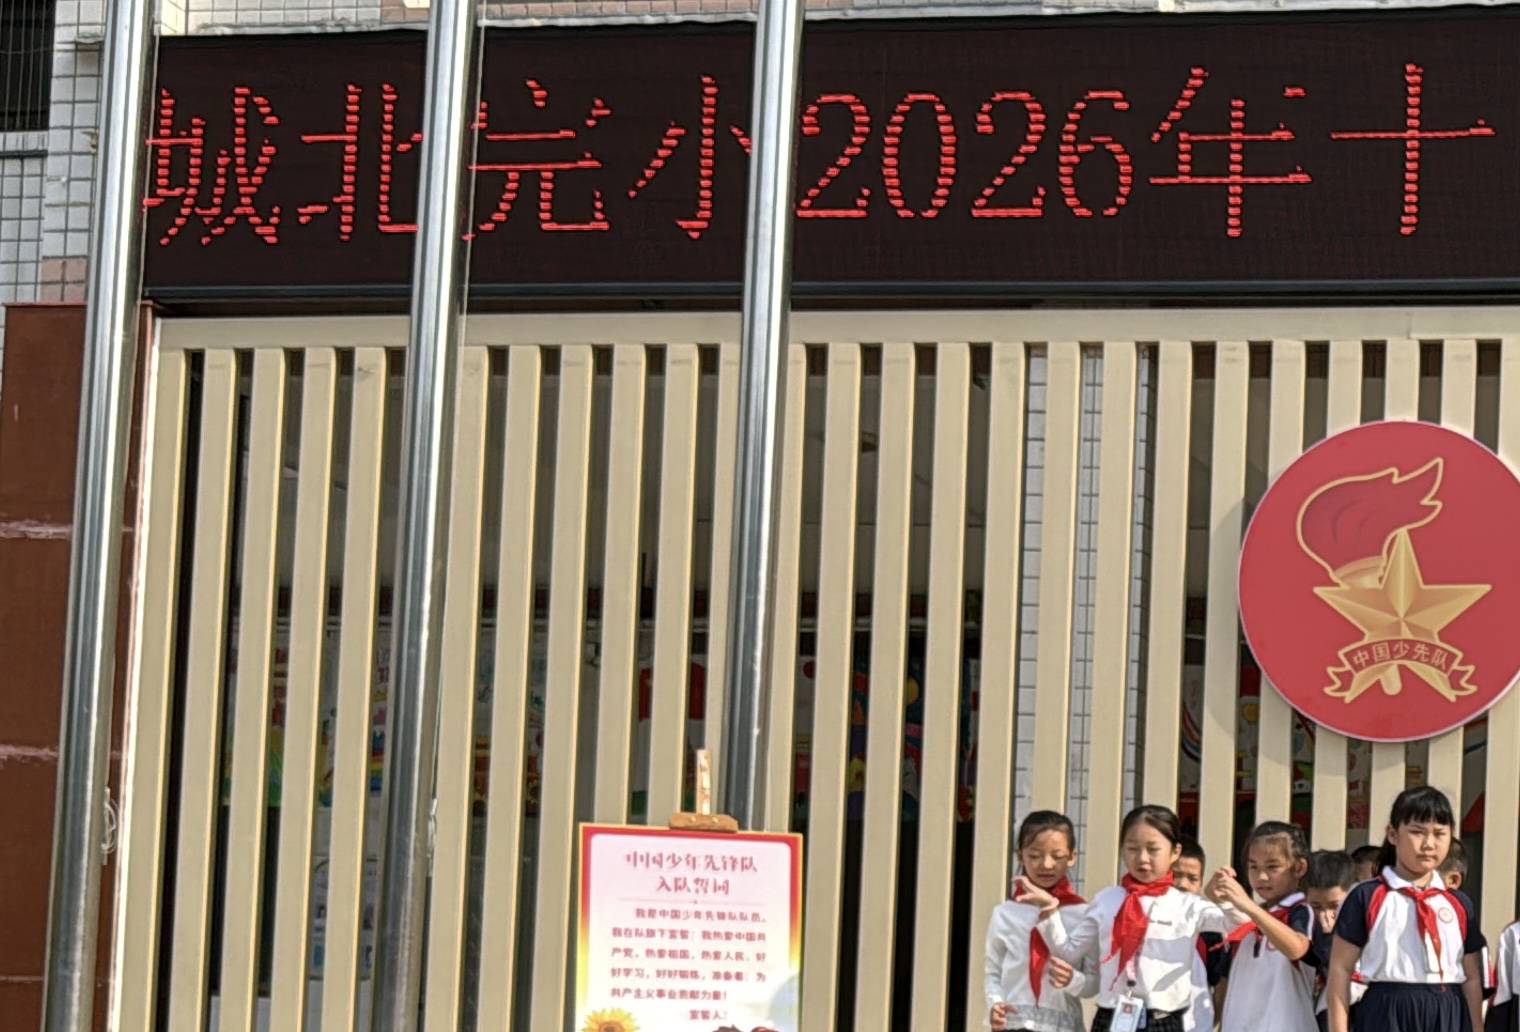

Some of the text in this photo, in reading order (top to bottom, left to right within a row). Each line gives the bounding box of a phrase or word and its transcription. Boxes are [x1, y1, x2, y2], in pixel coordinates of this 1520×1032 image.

[1353, 640, 1451, 671] 中国少先队
[626, 851, 757, 872] 中国少年先锋队
[656, 875, 730, 895] 入队誓词
